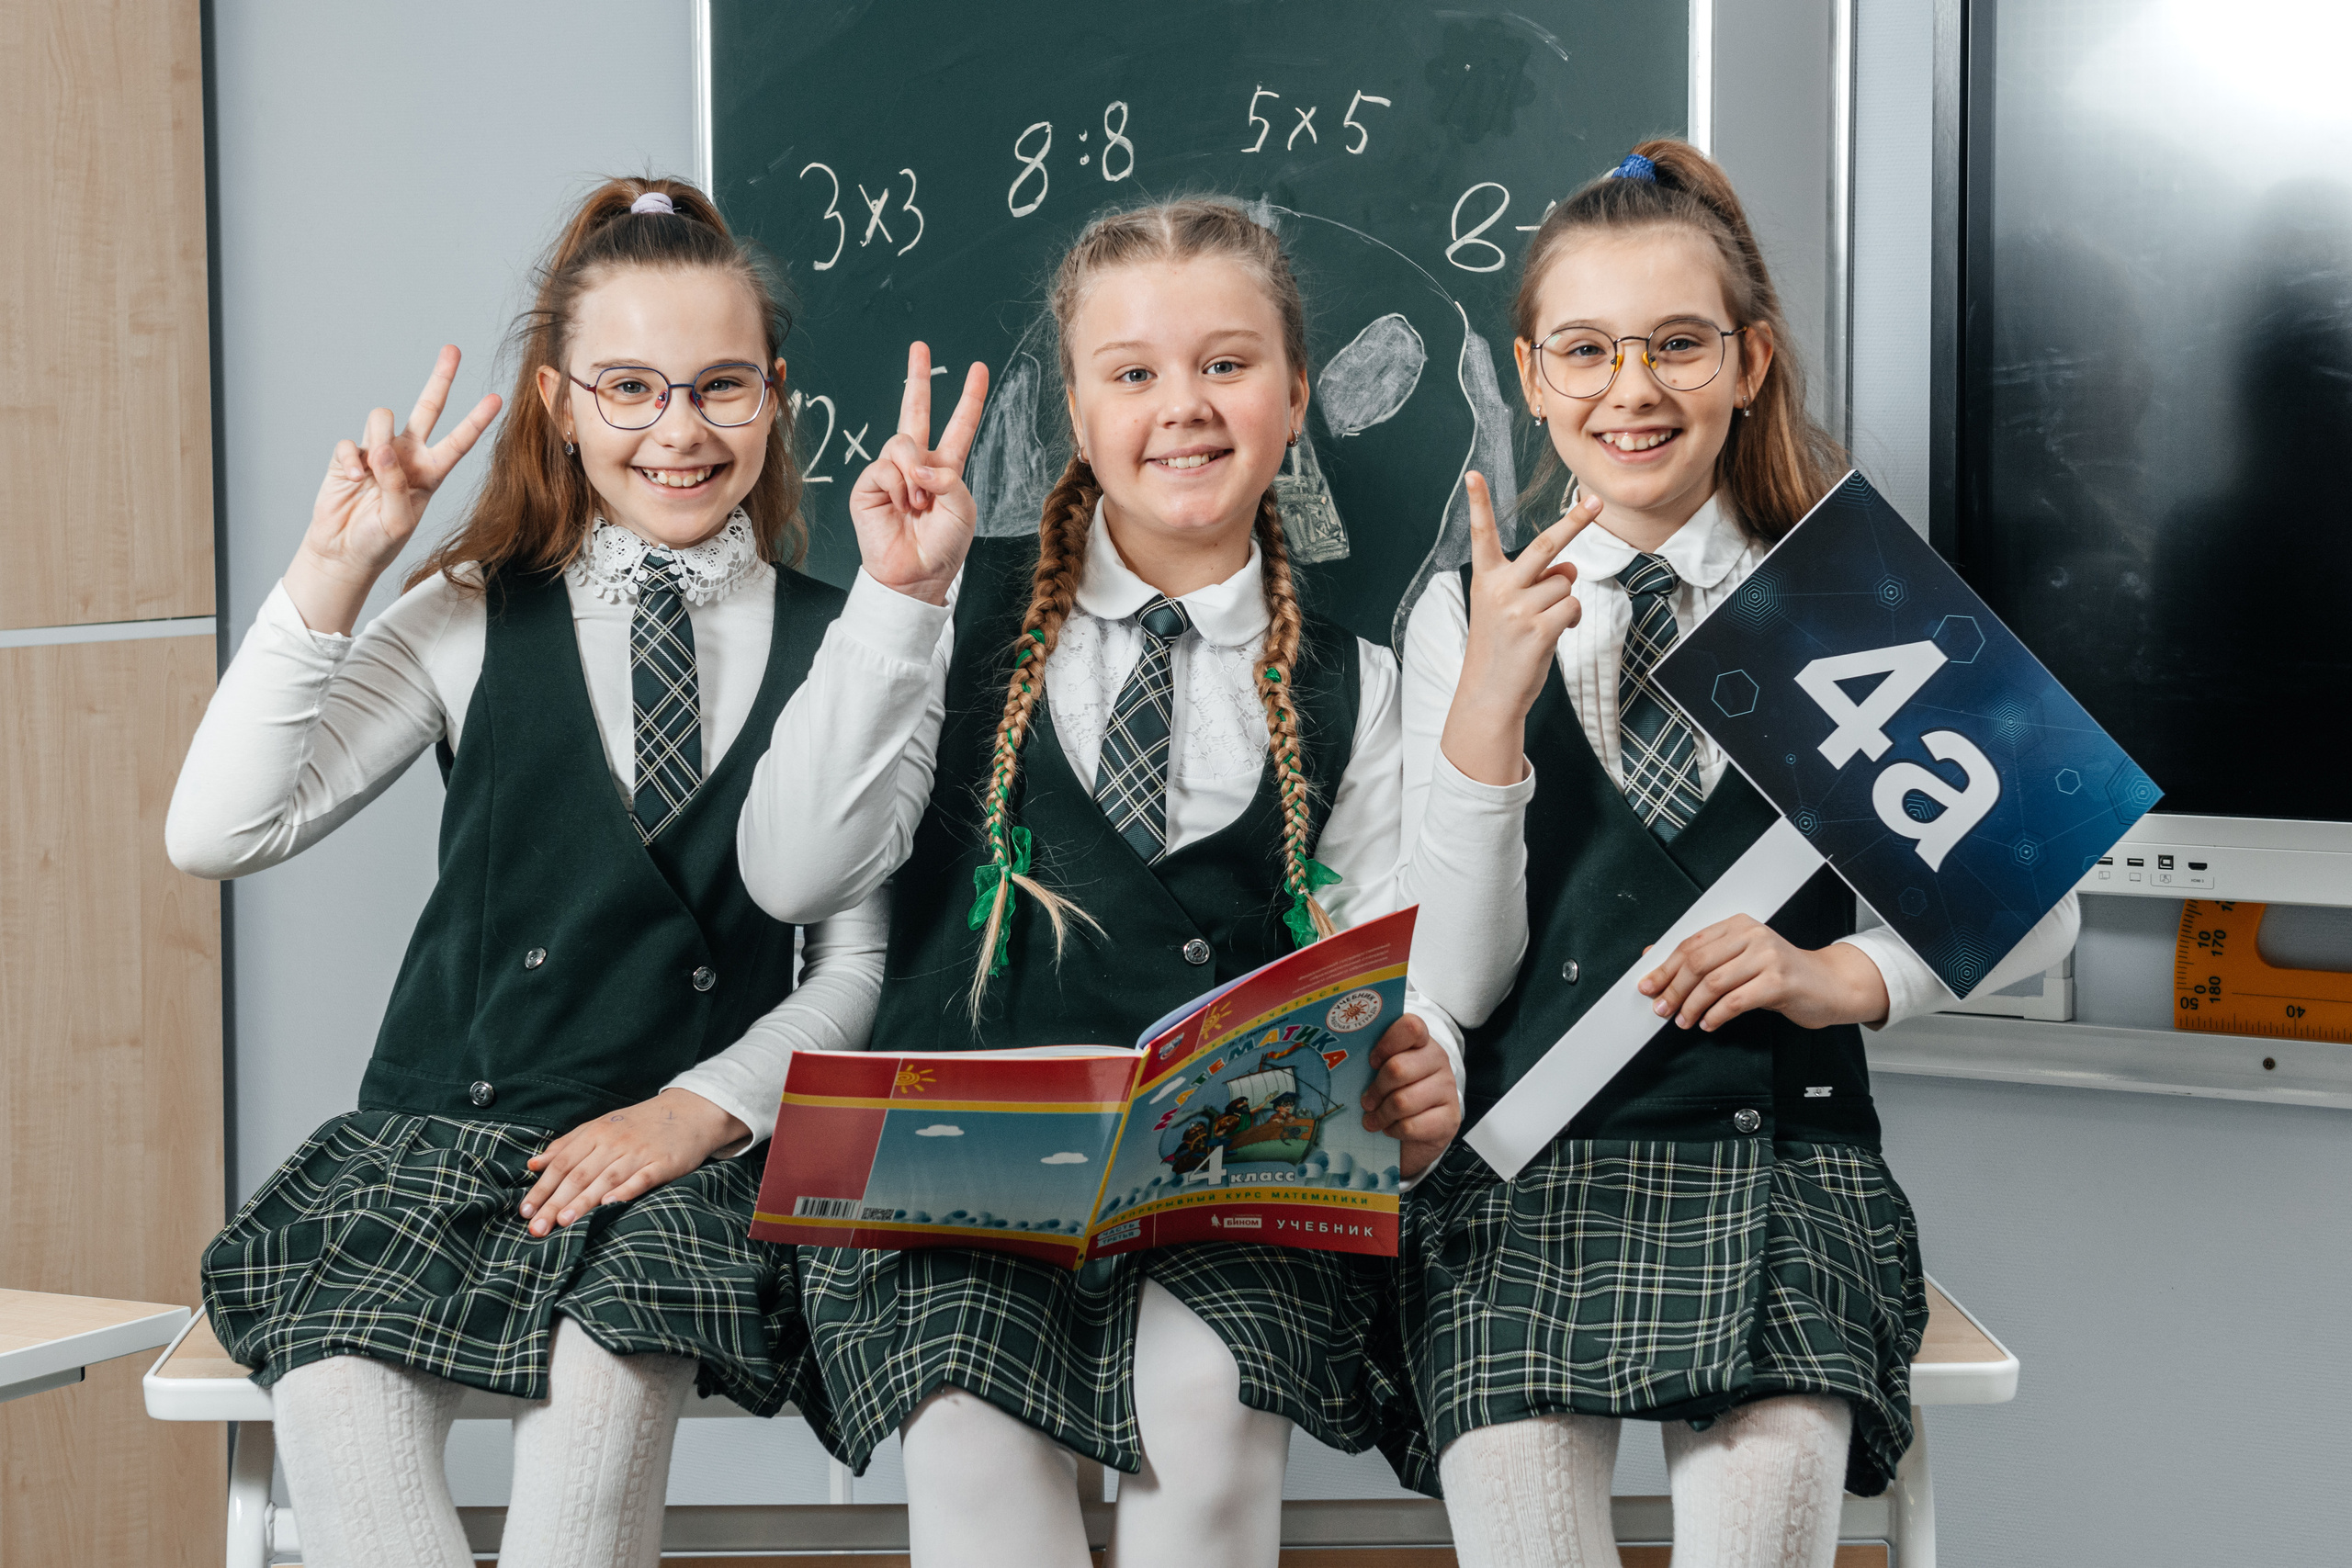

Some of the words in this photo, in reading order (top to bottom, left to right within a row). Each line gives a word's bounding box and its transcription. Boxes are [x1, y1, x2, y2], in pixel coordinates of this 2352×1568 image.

[2197, 931, 2211, 949] 10
[2211, 929, 2227, 957] 170
[2194, 985, 2206, 995] 0
[2208, 976, 2222, 1004] 180
[1334, 992, 1376, 1010] УЧЕБНИК
[2180, 997, 2199, 1010] 50
[2286, 1005, 2306, 1019] 40
[1152, 1024, 1348, 1132] МАТЕМАТИКА
[1189, 1145, 1228, 1186] 4
[1229, 1170, 1295, 1184] класс
[1111, 1193, 1216, 1224] НЕПРЕРЫВНЫЙ
[1225, 1191, 1262, 1200] КУРС
[1271, 1191, 1368, 1205] МАТЕМАТИКИ
[1102, 1223, 1136, 1236] ЧАСТЬ
[1227, 1217, 1260, 1226] БИНОМ
[1276, 1219, 1374, 1238] УЧЕБНИК
[1102, 1231, 1135, 1246] ТРЕТЬЯ
